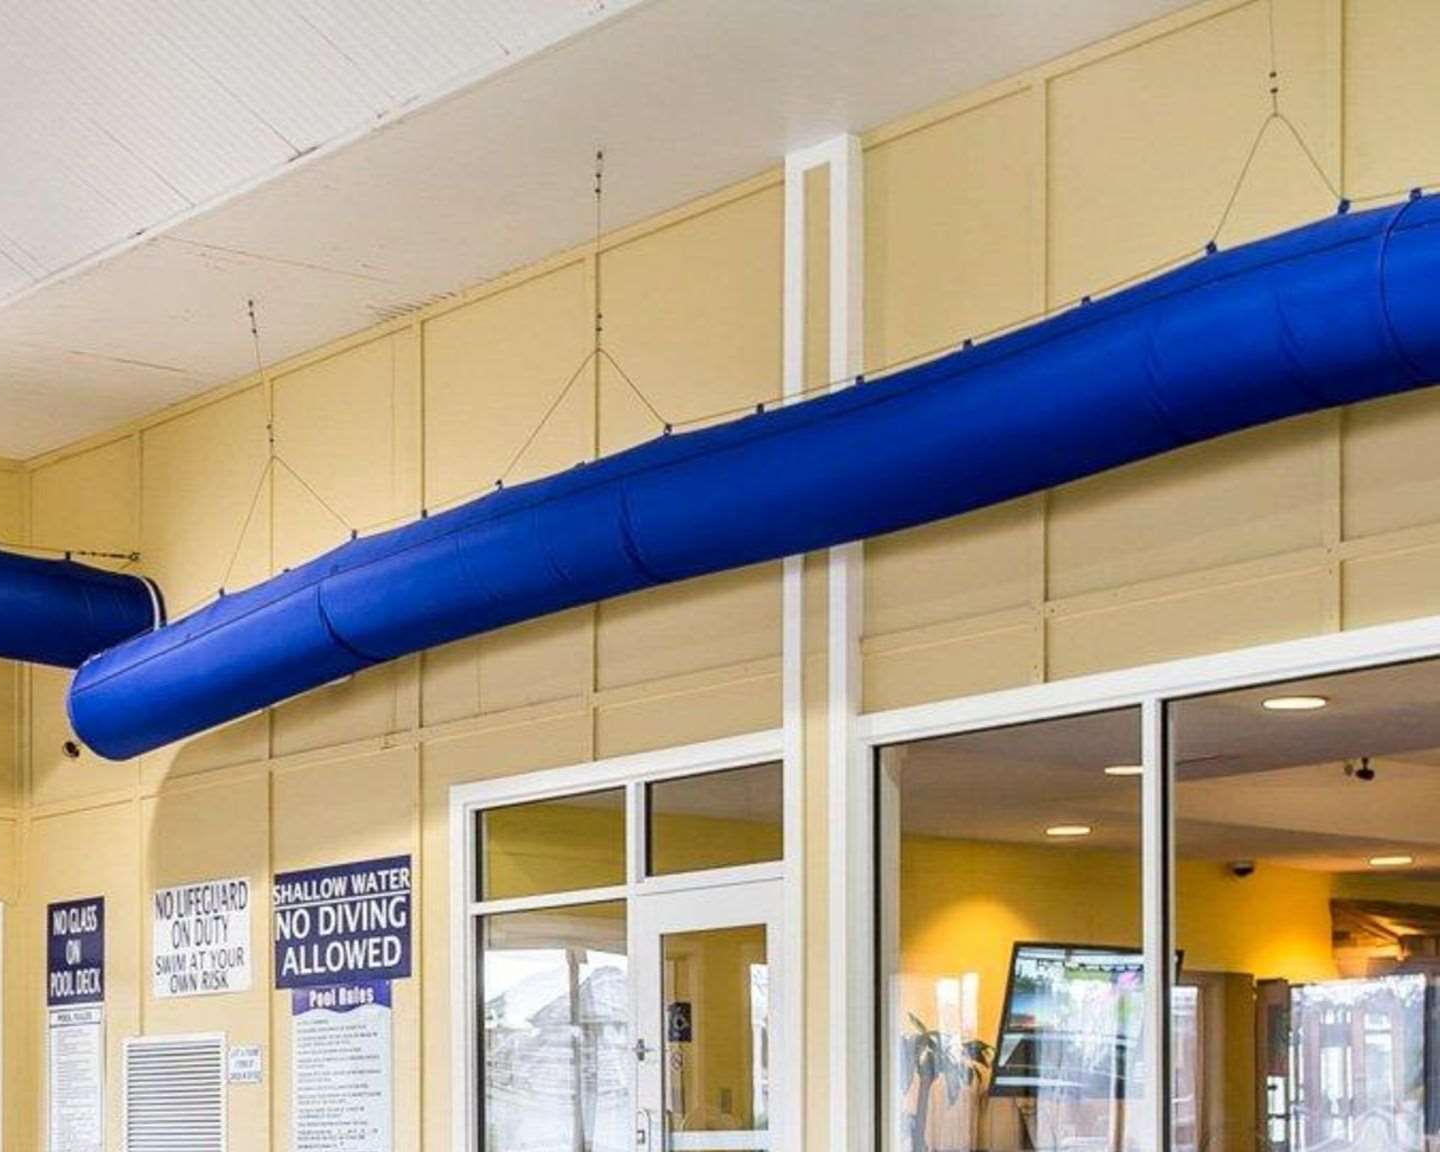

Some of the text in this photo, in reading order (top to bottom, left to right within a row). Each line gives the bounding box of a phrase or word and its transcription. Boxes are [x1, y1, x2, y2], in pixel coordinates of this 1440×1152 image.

[155, 880, 248, 920] NO LIFEGUARD
[273, 867, 410, 905] SHALLOW WATER
[53, 909, 68, 936] NO
[172, 915, 228, 949] ON DUTY
[275, 895, 408, 941] NO DIVING
[66, 938, 81, 966] ON
[155, 946, 245, 976] SWIM AT YOUR
[281, 935, 403, 977] ALLOWED
[50, 966, 102, 997] POOL DECK
[170, 969, 230, 993] OWN RISK
[309, 989, 336, 1008] Pool
